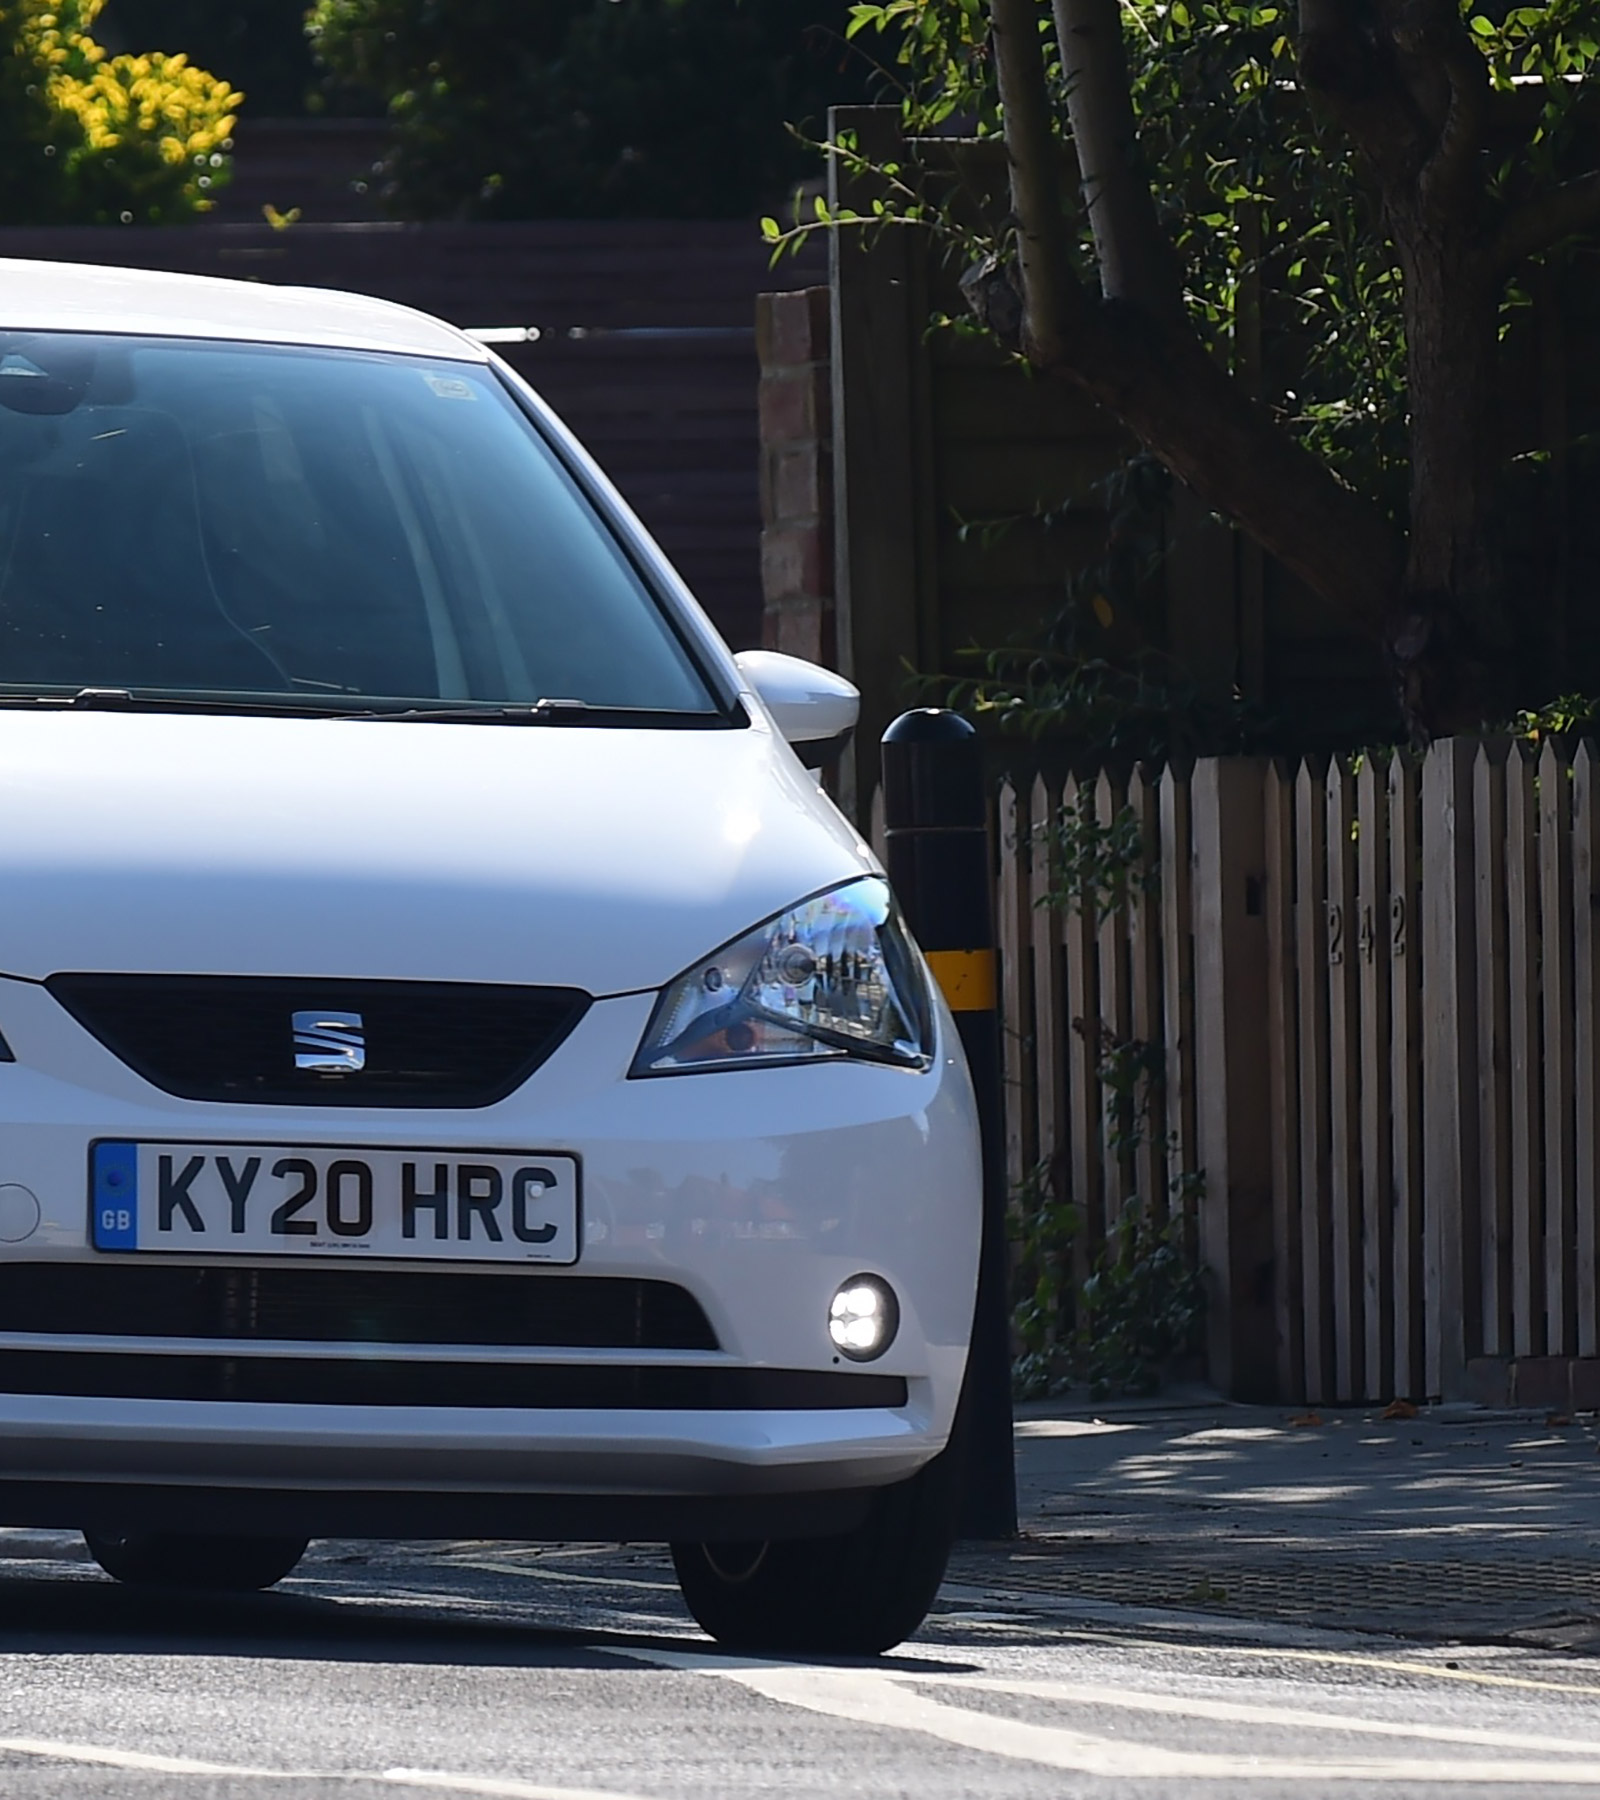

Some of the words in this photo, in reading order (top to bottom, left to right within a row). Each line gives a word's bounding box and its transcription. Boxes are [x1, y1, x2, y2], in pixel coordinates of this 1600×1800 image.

[1329, 894, 1405, 965] 242
[102, 1209, 130, 1230] GB
[157, 1154, 373, 1237] KY20
[401, 1162, 558, 1243] HRC
